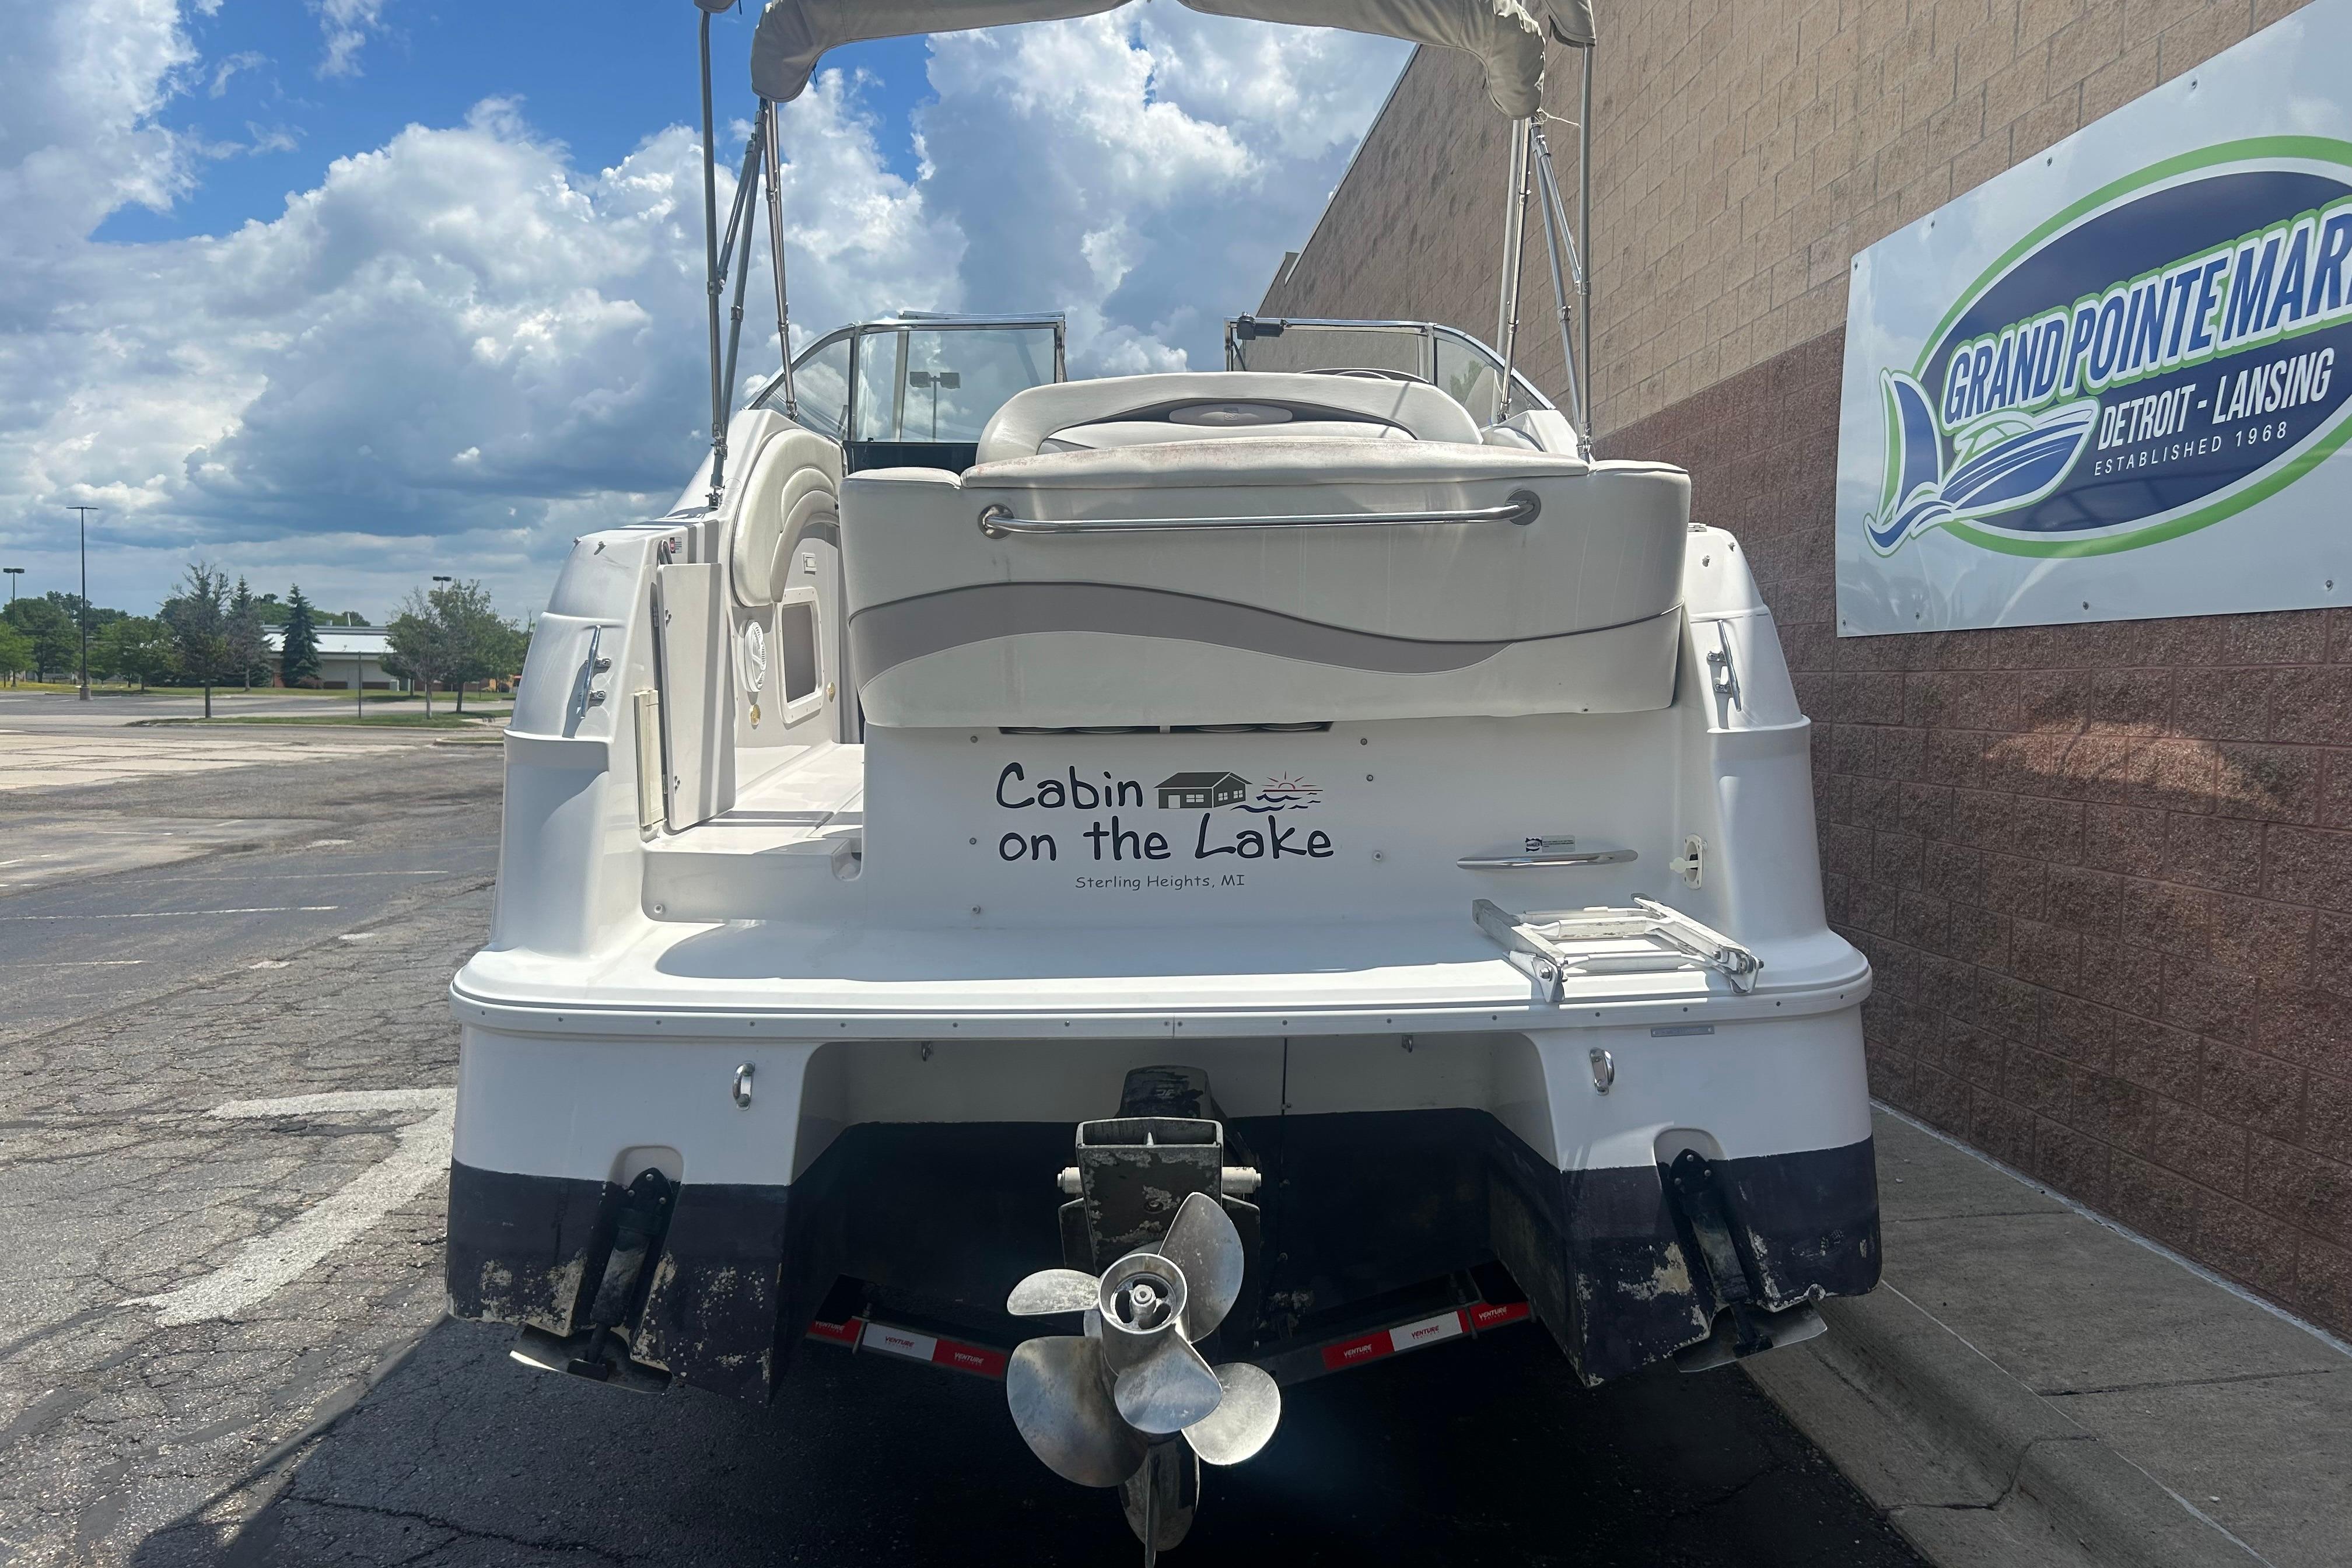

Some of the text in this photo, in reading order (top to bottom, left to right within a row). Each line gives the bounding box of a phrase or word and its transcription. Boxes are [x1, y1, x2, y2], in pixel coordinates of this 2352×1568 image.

[1944, 214, 2352, 425] GRAND POINTE MAR
[2097, 346, 2336, 451] DETROIT - LANSING
[2094, 421, 2287, 476] ESTABLISHED 1968
[996, 761, 1144, 810] Cabin
[998, 812, 1335, 861] on the Lake
[1075, 874, 1245, 891] Sterling Heights, MI
[1478, 1306, 1507, 1318] VENTURE
[816, 1320, 845, 1331] VENTURE
[1411, 1325, 1440, 1338] VENTURE
[885, 1335, 915, 1348] VENTURE
[1343, 1343, 1372, 1357] VENTURE
[954, 1352, 985, 1364] VENTURE
